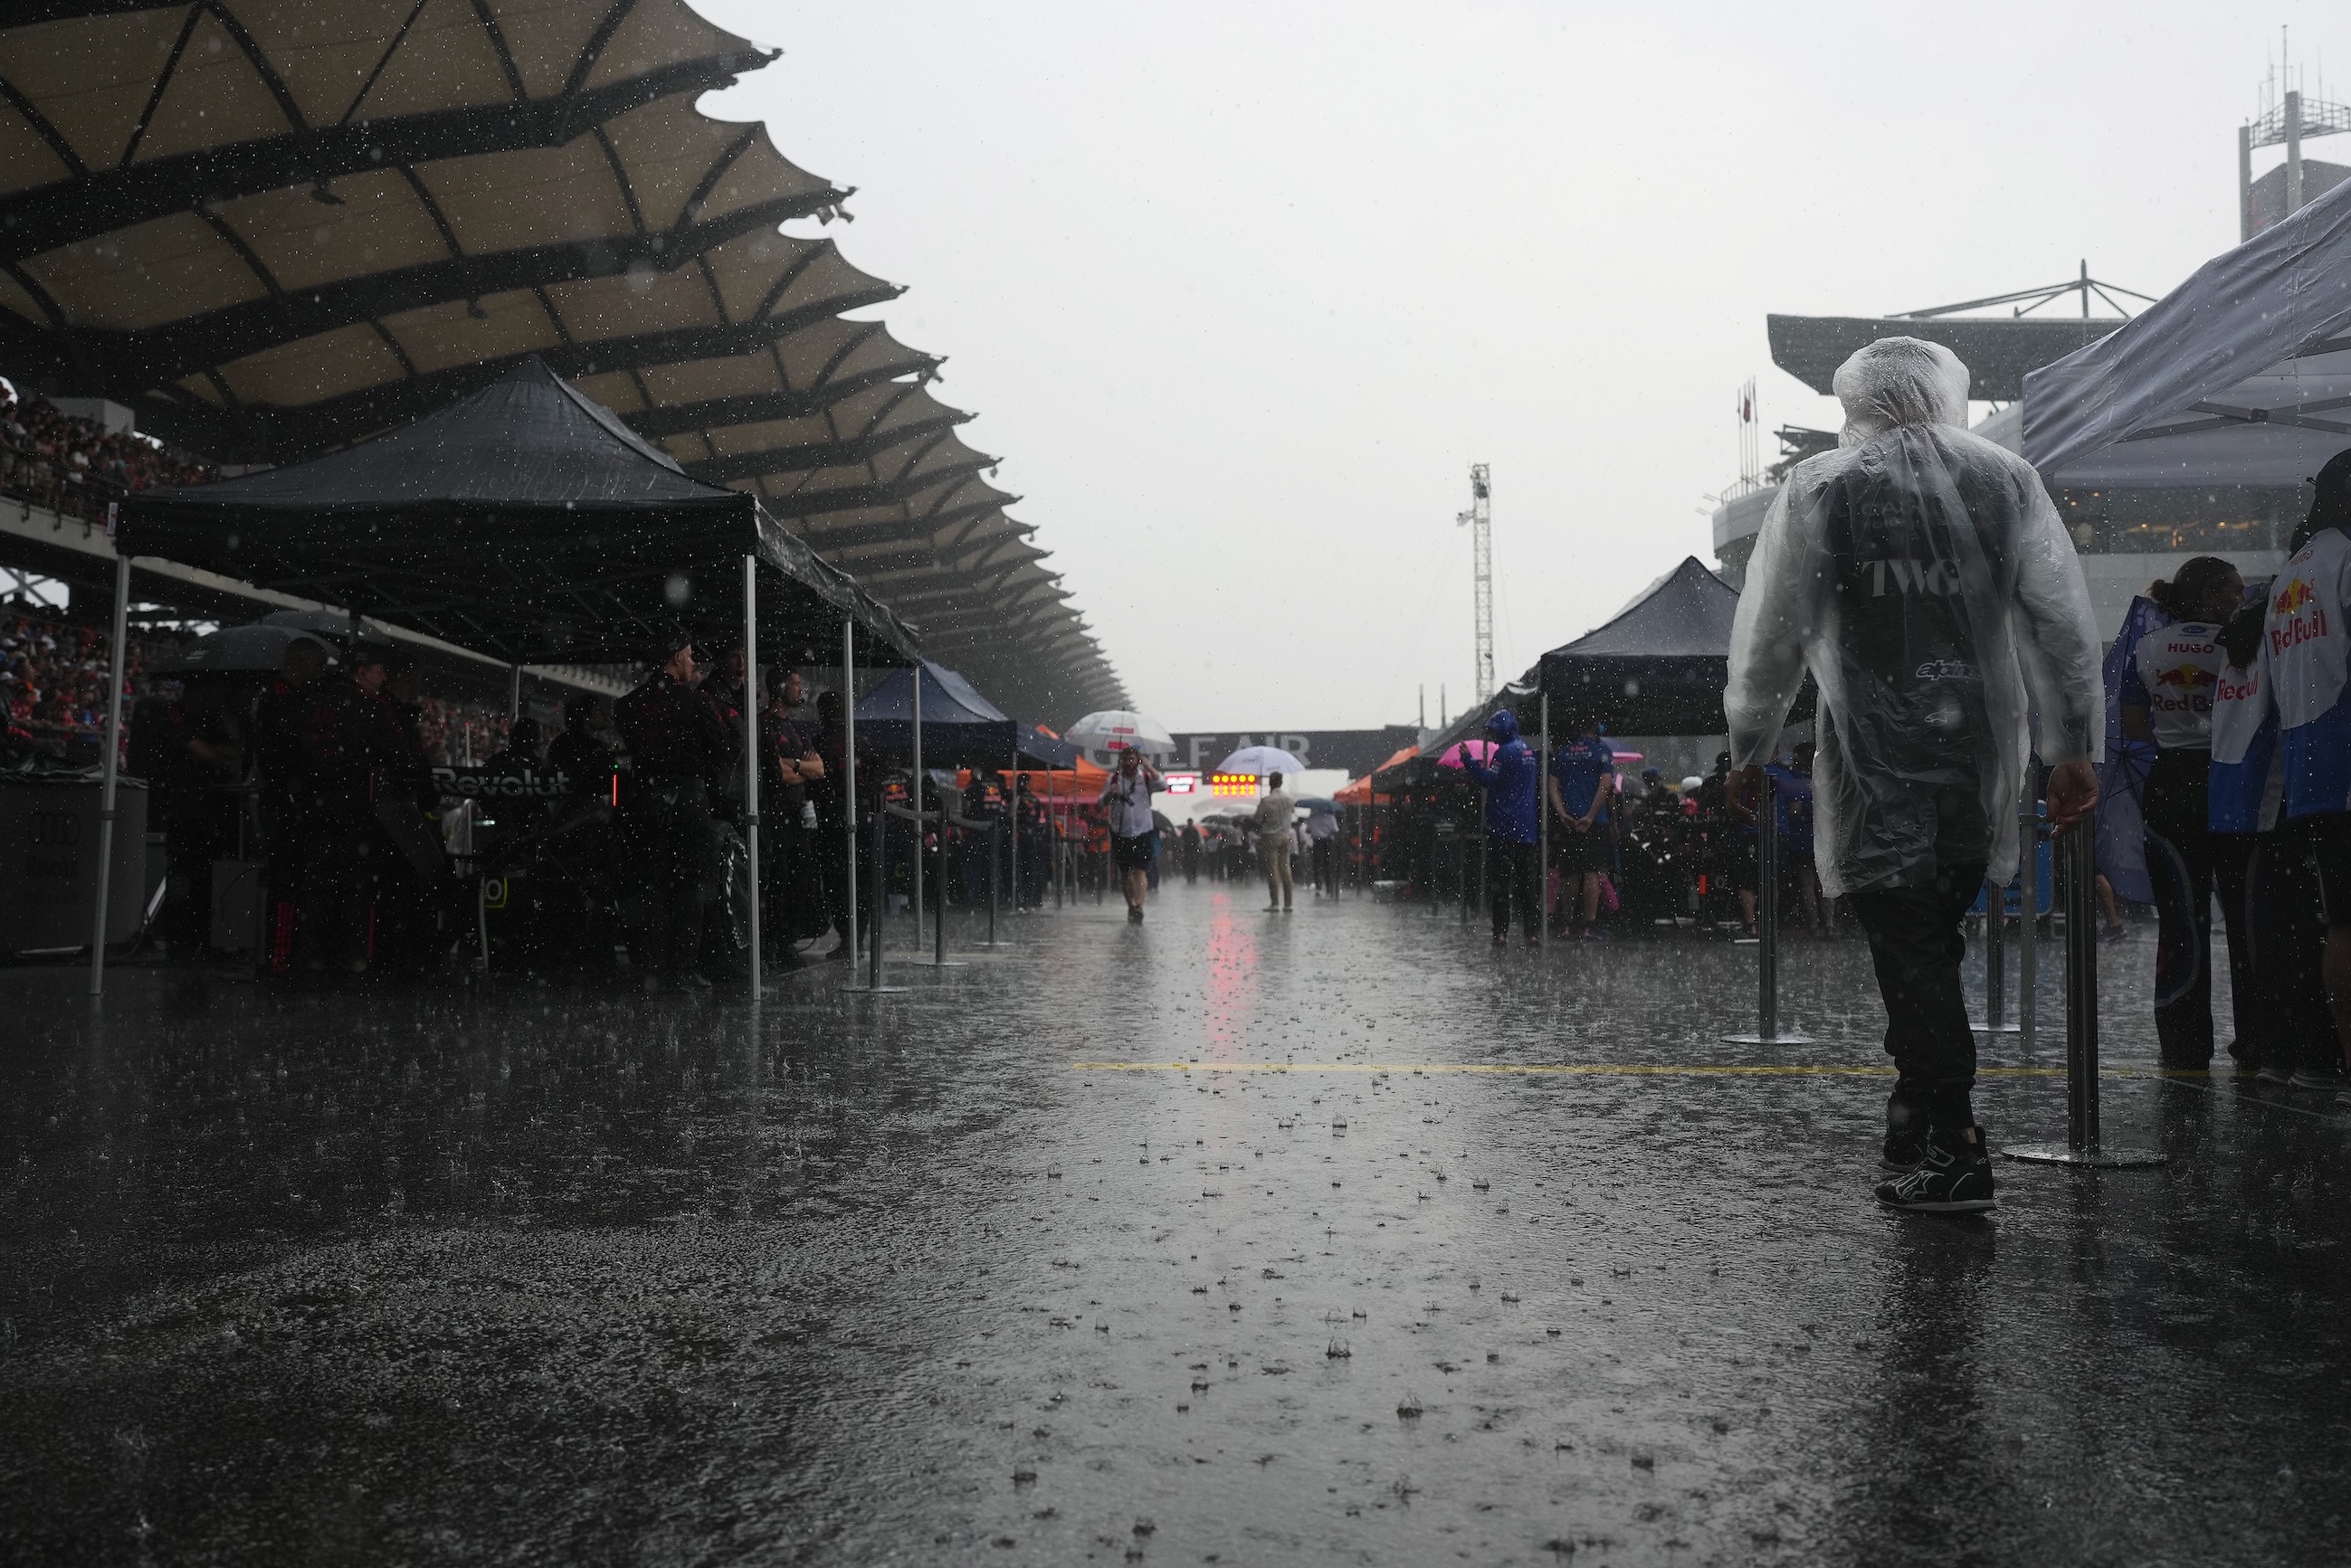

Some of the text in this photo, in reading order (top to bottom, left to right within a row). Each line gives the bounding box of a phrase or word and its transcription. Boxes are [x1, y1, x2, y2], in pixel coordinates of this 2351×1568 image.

[2168, 643, 2214, 654] HUGO
[2153, 694, 2190, 712] Red
[432, 767, 573, 796] Revolut
